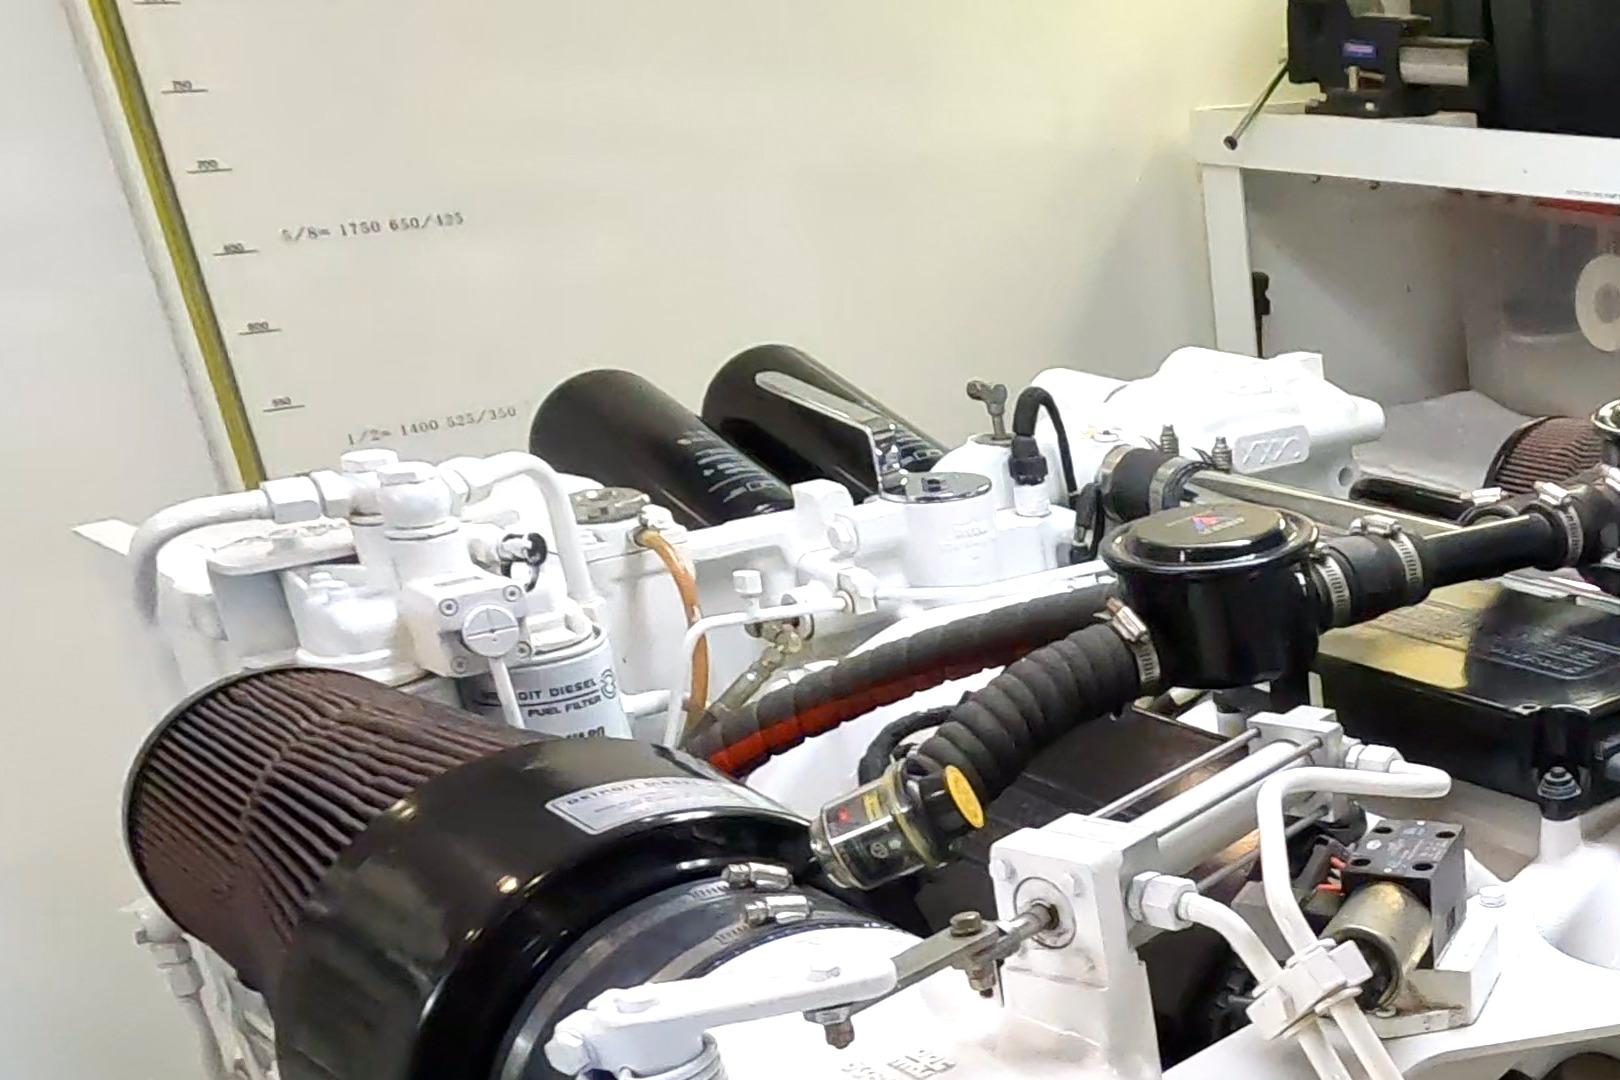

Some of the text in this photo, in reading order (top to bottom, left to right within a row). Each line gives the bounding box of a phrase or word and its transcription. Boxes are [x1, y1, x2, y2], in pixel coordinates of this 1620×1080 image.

[400, 419, 439, 437] 1400
[549, 678, 598, 697] DIESEL
[527, 695, 602, 718] FUEL FILTER
